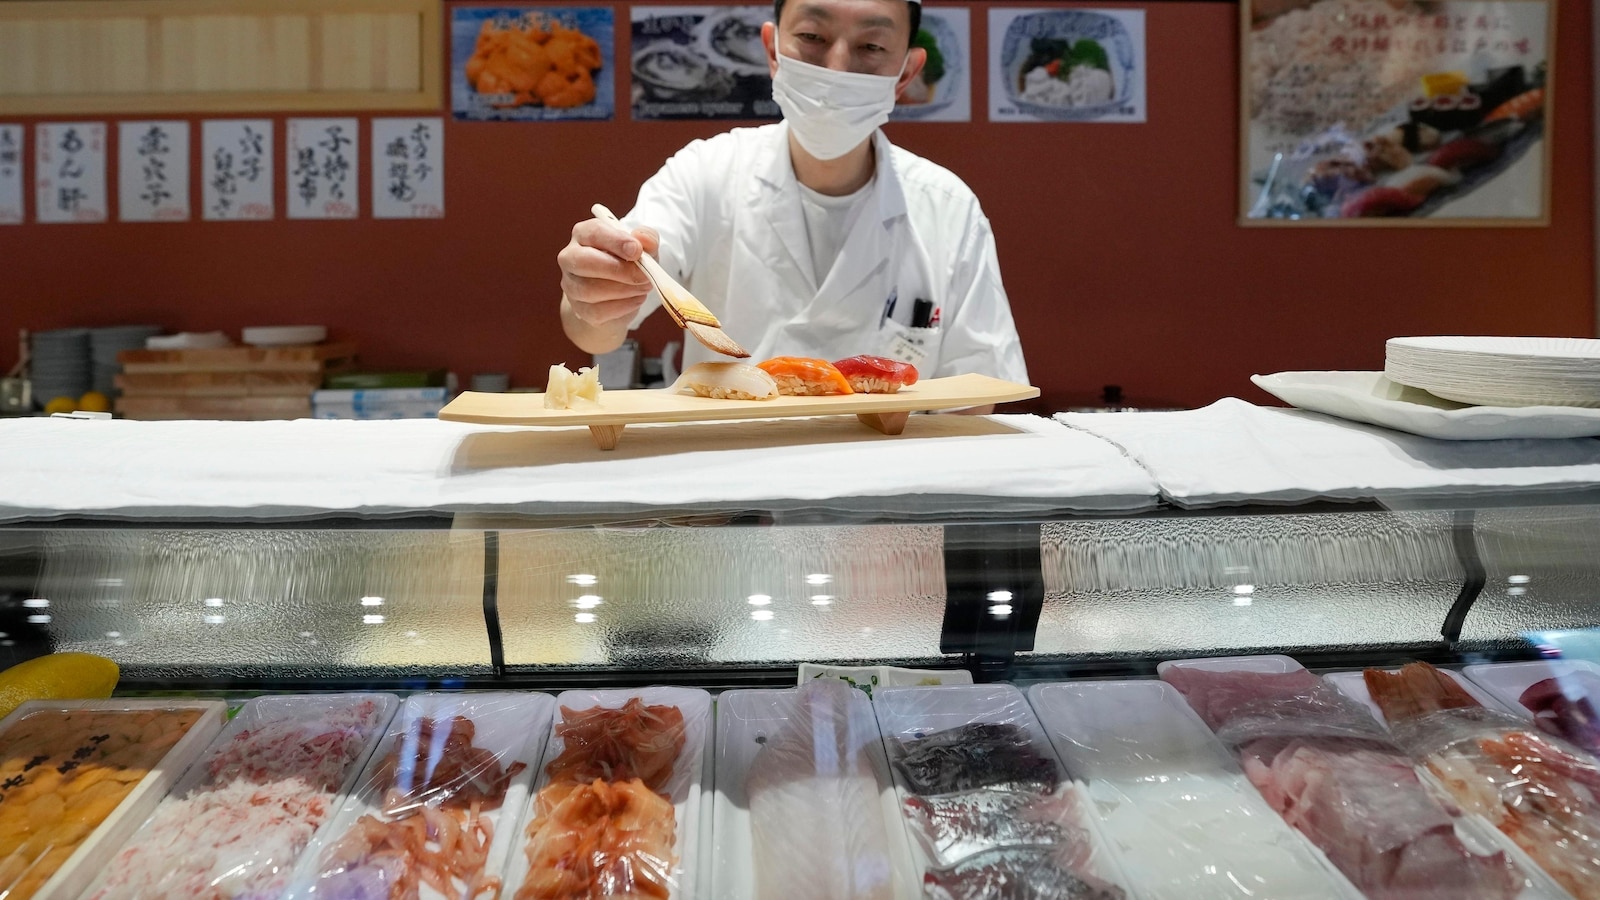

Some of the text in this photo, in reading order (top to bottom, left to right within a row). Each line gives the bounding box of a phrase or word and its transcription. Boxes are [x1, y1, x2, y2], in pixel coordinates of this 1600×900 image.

[57, 128, 88, 212] あん肝
[410, 122, 433, 182] ホタテ
